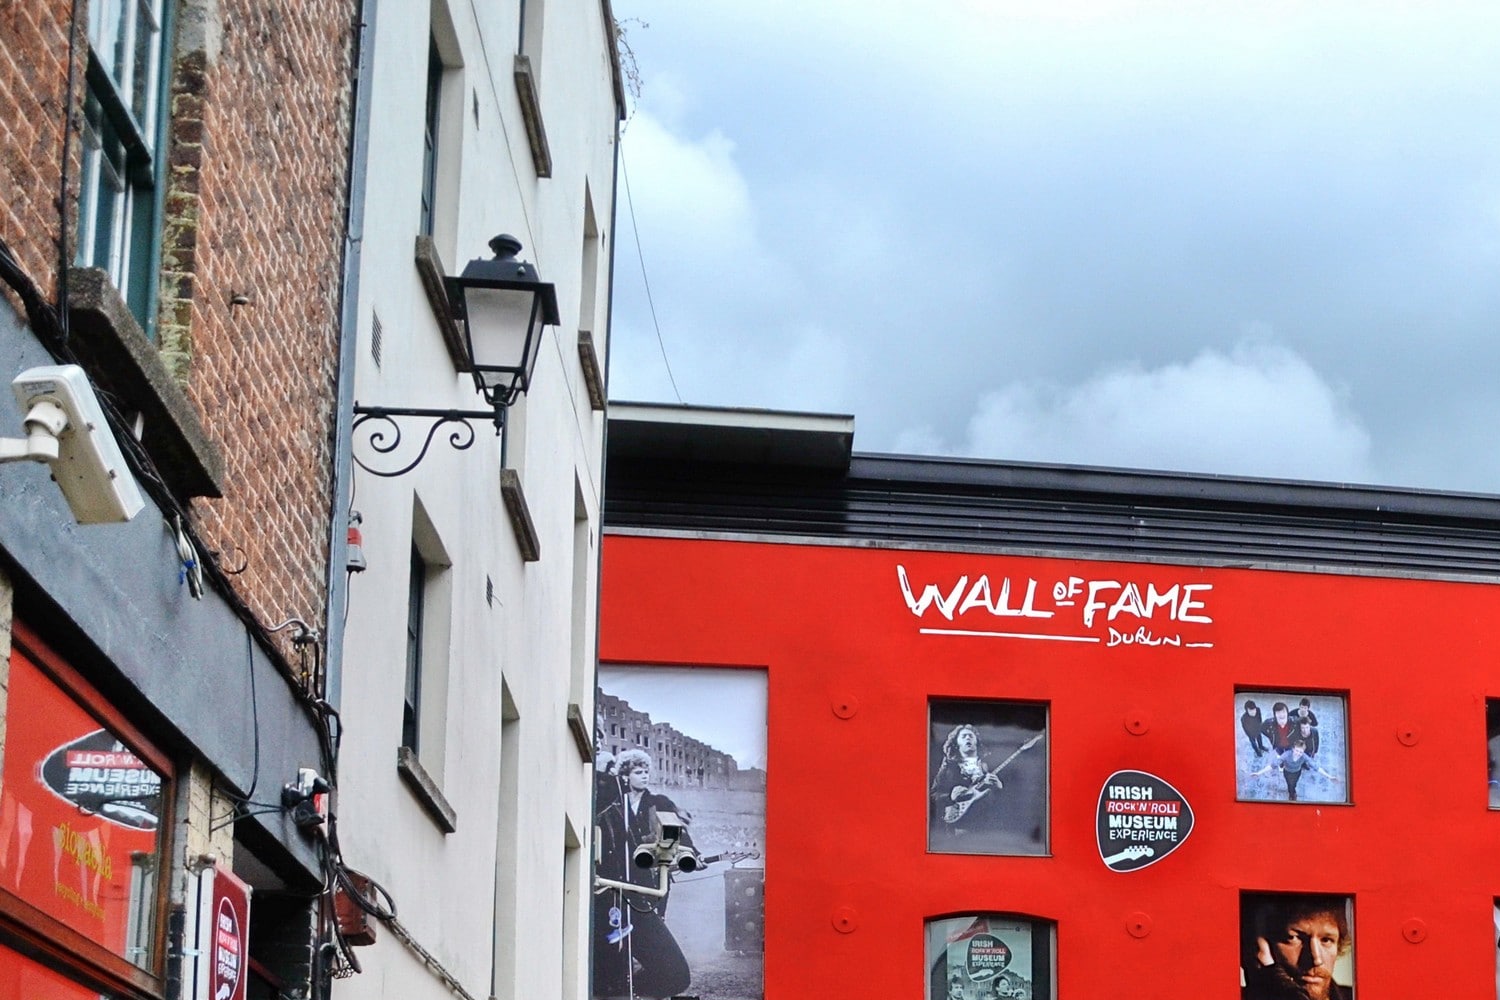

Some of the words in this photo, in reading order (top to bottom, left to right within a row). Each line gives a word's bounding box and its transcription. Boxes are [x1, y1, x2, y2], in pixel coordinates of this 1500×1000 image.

[896, 565, 1055, 620] WALL
[1052, 576, 1085, 606] OF
[1084, 580, 1213, 628] FAME
[1109, 786, 1152, 801] IRISH
[1108, 815, 1178, 830] MUSEUM
[1109, 829, 1178, 842] EXPERIENCE
[971, 940, 994, 948] IRISH
[971, 954, 1005, 962] MUSEUM
